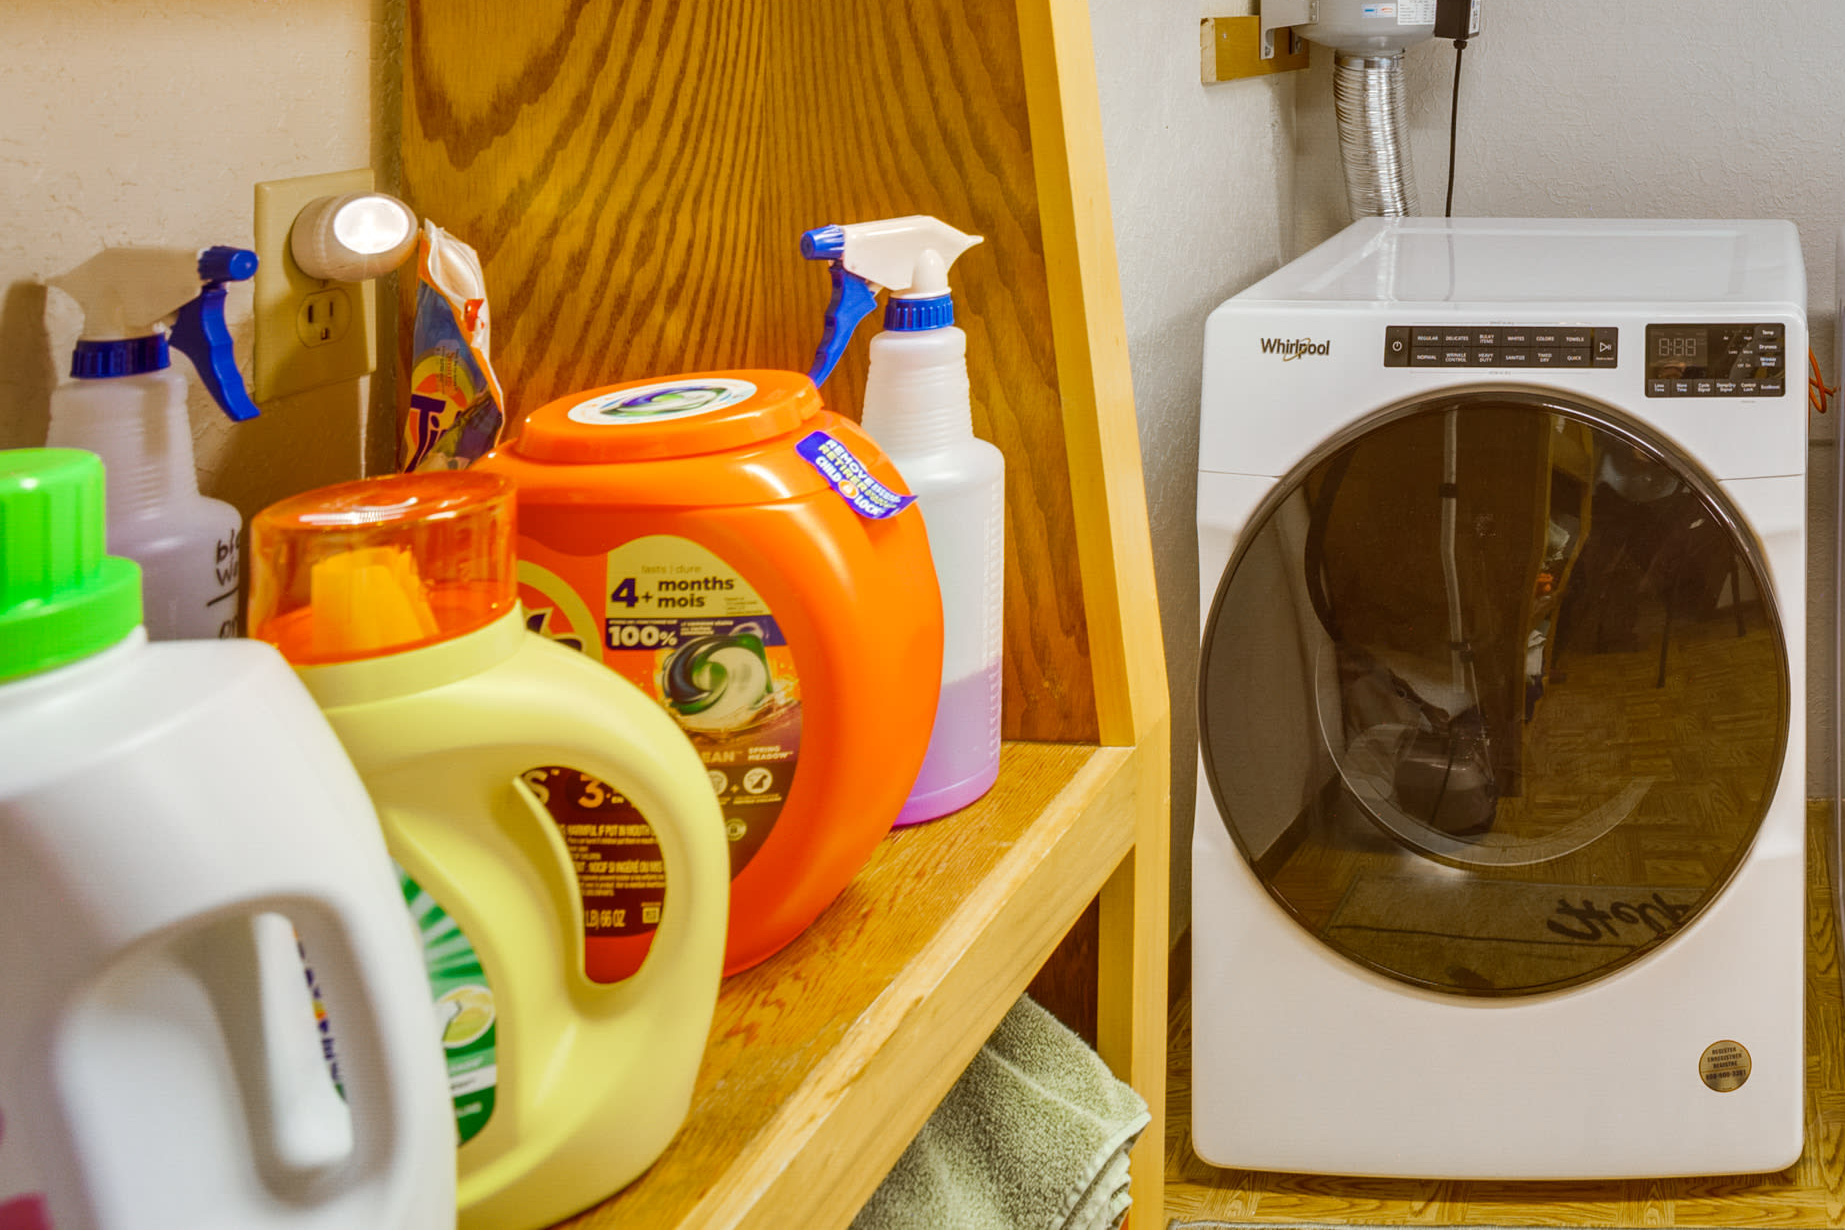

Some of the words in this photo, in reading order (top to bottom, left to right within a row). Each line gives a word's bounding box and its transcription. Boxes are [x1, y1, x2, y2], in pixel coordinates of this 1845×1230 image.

[1261, 337, 1330, 360] Whirlpool
[818, 444, 868, 492] RETIRER
[824, 439, 875, 487] REMOVE
[816, 456, 842, 482] CHILD
[854, 495, 882, 516] LOCK
[641, 564, 667, 574] lasts
[675, 563, 702, 574] dure
[658, 576, 734, 591] months
[658, 593, 705, 608] mois
[608, 625, 678, 647] 100%
[748, 746, 780, 754] SPRING
[567, 824, 597, 837] HARMFUL
[599, 824, 605, 836] IF
[605, 824, 618, 836] PUT
[619, 824, 626, 836] IN
[626, 824, 650, 836] MOUTH
[588, 862, 608, 873] NOCIF
[608, 862, 616, 873] SI
[600, 910, 612, 927] 66
[613, 910, 626, 927] OZ
